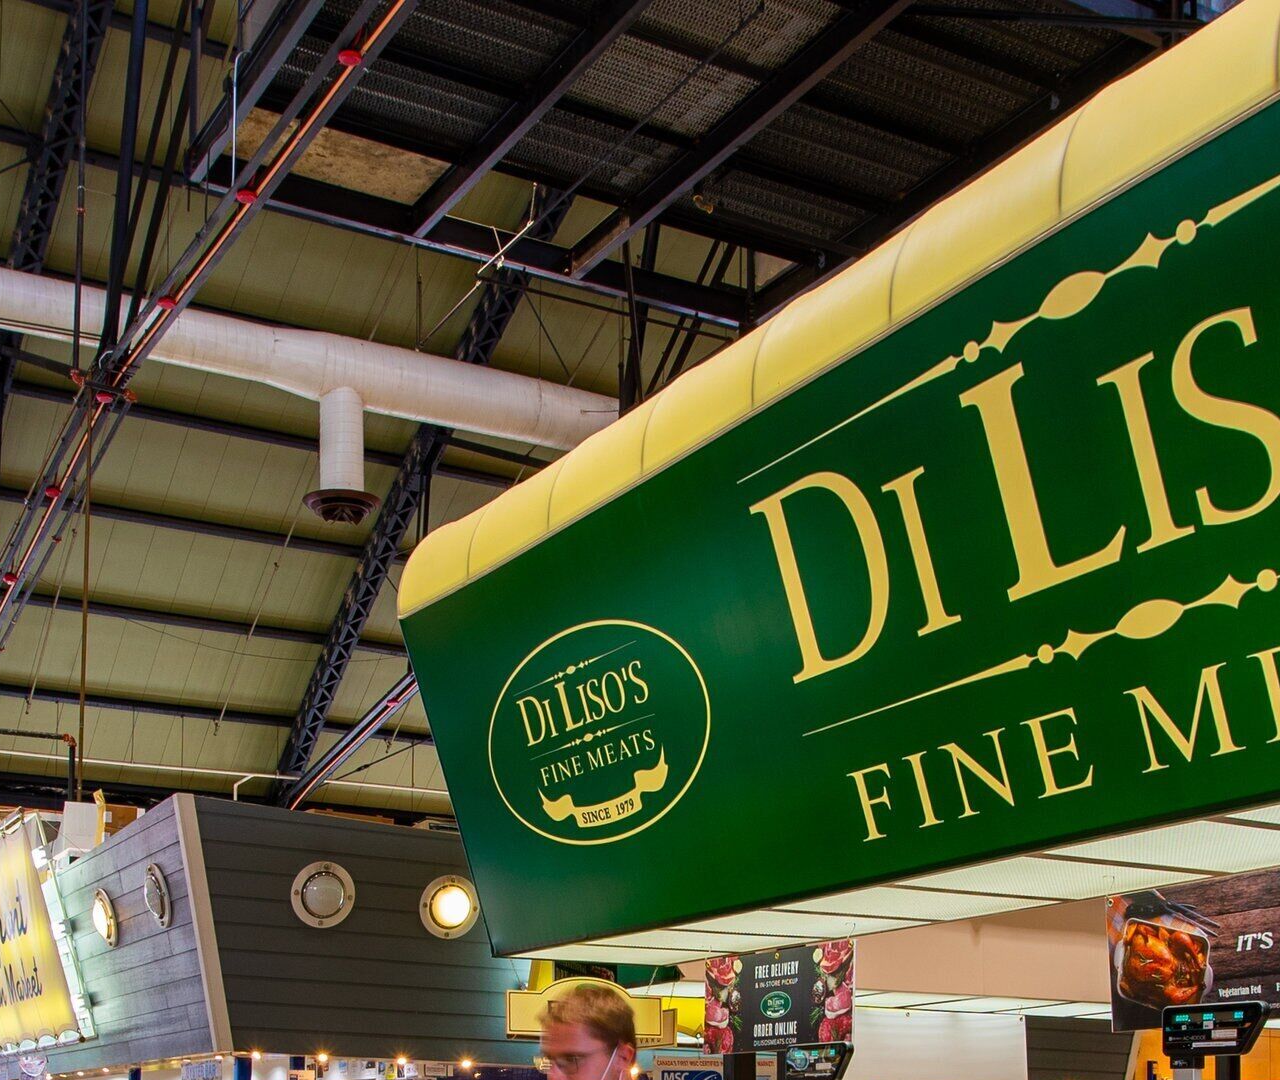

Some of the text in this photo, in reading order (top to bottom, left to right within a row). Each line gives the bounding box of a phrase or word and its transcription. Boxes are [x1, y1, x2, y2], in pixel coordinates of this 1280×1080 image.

[540, 730, 655, 786] FINE MEATS
[847, 708, 1093, 842] FINE
[581, 798, 634, 824] SINCE 1979
[1236, 932, 1274, 952] IT'S
[754, 960, 799, 979] FREE DELIVERY
[1218, 984, 1261, 998] Vegetarian Fed
[754, 1020, 798, 1038] ORDER ONLINE
